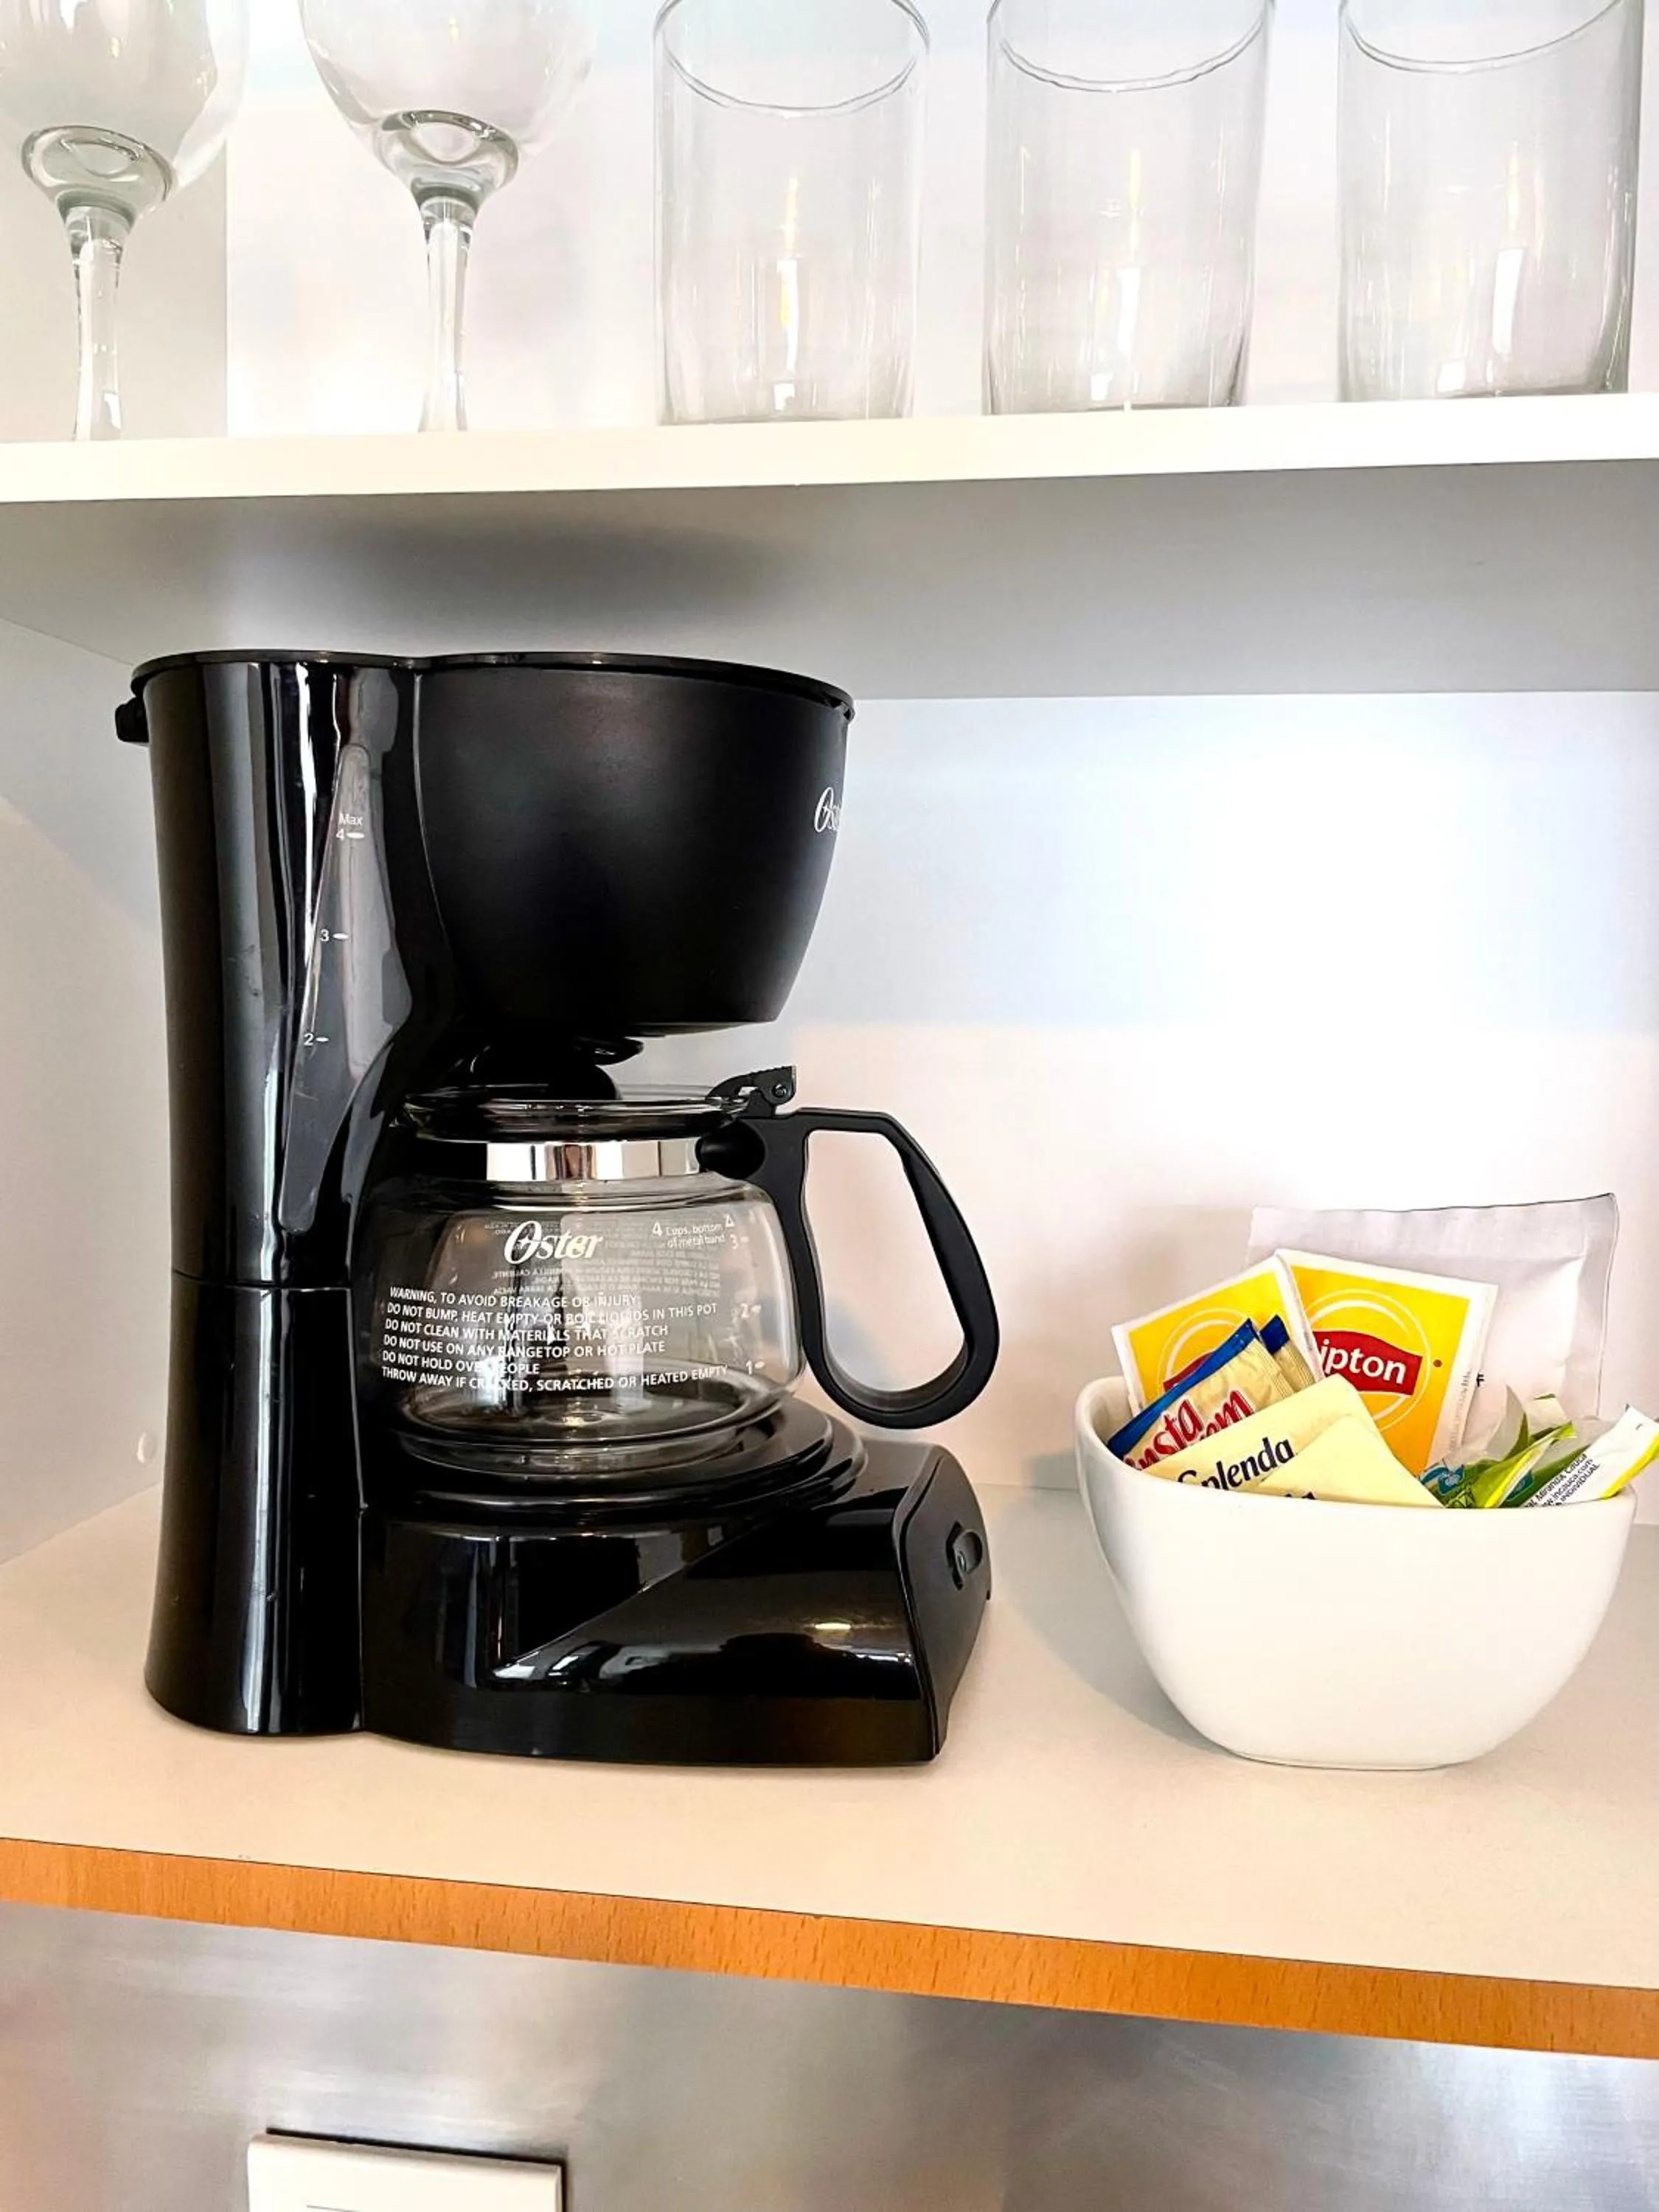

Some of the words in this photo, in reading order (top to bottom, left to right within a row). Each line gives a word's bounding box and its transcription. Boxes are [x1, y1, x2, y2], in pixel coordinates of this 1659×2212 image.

[338, 813, 364, 827] Max
[692, 1222, 723, 1234] bottom
[504, 1220, 603, 1265] Oster
[390, 1286, 437, 1304] WARNING,
[441, 1292, 456, 1304] TO
[458, 1294, 496, 1307] AVOID
[500, 1296, 568, 1307] BREAKAGE
[594, 1294, 637, 1307] INJURY
[387, 1302, 400, 1315] DO
[402, 1304, 424, 1318] NOT
[462, 1311, 494, 1324] HEAT
[496, 1312, 539, 1325] EMPTY
[543, 1312, 563, 1325] OR
[599, 1309, 650, 1325] LIQUIDS
[653, 1308, 665, 1320] IN
[668, 1305, 694, 1318] THIS
[697, 1303, 717, 1315] POT
[386, 1318, 399, 1330] DO
[400, 1321, 422, 1334] NOT
[424, 1324, 459, 1338] CLEAN
[463, 1329, 495, 1340] WITH
[498, 1329, 570, 1341] MATERIALS
[574, 1329, 608, 1340] THAT
[611, 1325, 669, 1339] SCRATCH
[383, 1335, 397, 1346] DO
[399, 1337, 420, 1350] NOT
[422, 1340, 443, 1353] USE
[446, 1343, 464, 1355] ON
[467, 1346, 495, 1357] ANY
[498, 1346, 571, 1359] RANGETOP
[574, 1346, 593, 1357] OR
[597, 1344, 626, 1357] HOT
[629, 1340, 666, 1354] PLATE
[383, 1350, 396, 1363] DO
[397, 1353, 420, 1366] NOT
[422, 1357, 452, 1370] HOLD
[456, 1360, 490, 1373] OVE
[495, 1362, 540, 1375] EOPLE
[1320, 1338, 1407, 1385] ipton
[382, 1366, 416, 1382] THROW
[419, 1372, 453, 1387] AWAY
[456, 1377, 467, 1388] IF
[536, 1377, 614, 1391] SCRATCHED
[619, 1376, 636, 1388] OR
[641, 1371, 688, 1386] HEATED
[691, 1364, 728, 1380] EMPTY
